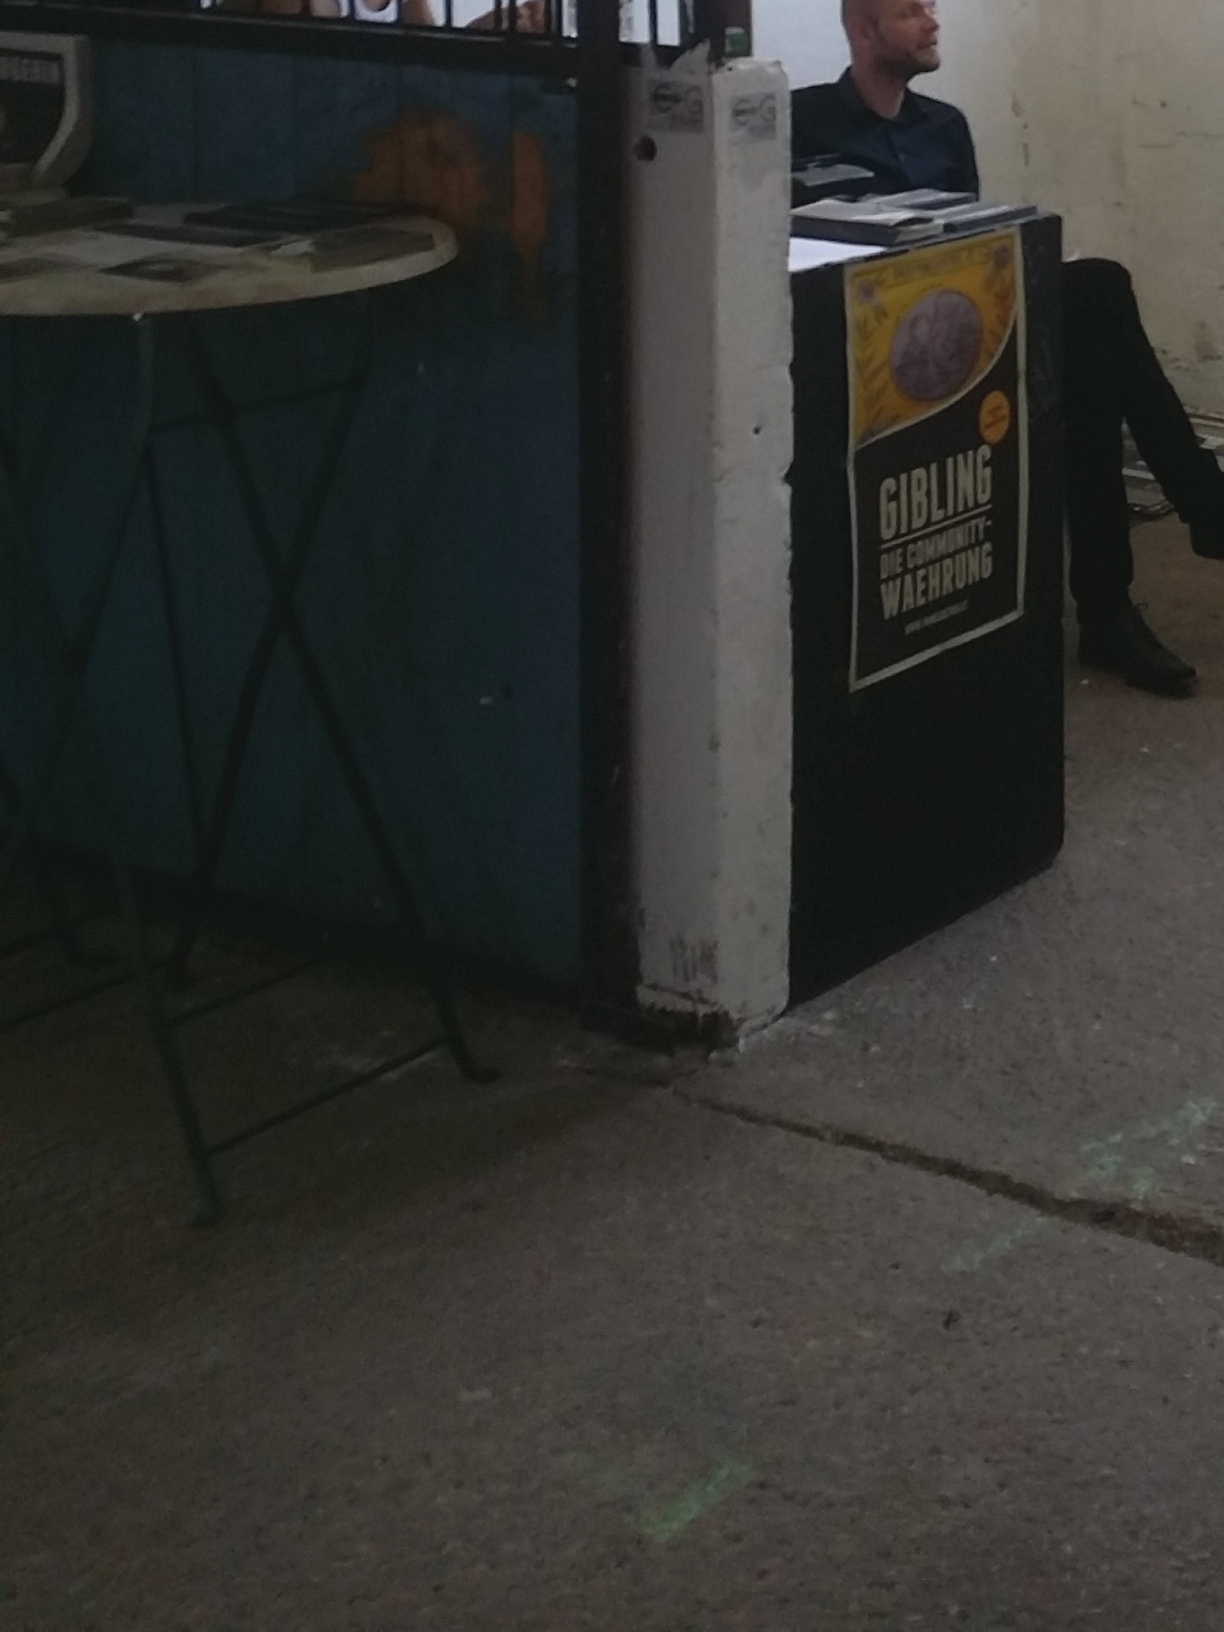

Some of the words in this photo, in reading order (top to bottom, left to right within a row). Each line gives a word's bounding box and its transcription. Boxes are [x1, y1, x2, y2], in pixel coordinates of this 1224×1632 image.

[880, 444, 992, 541] GIBLING
[880, 547, 904, 580] DIE
[880, 541, 993, 620] WAEHRUNG
